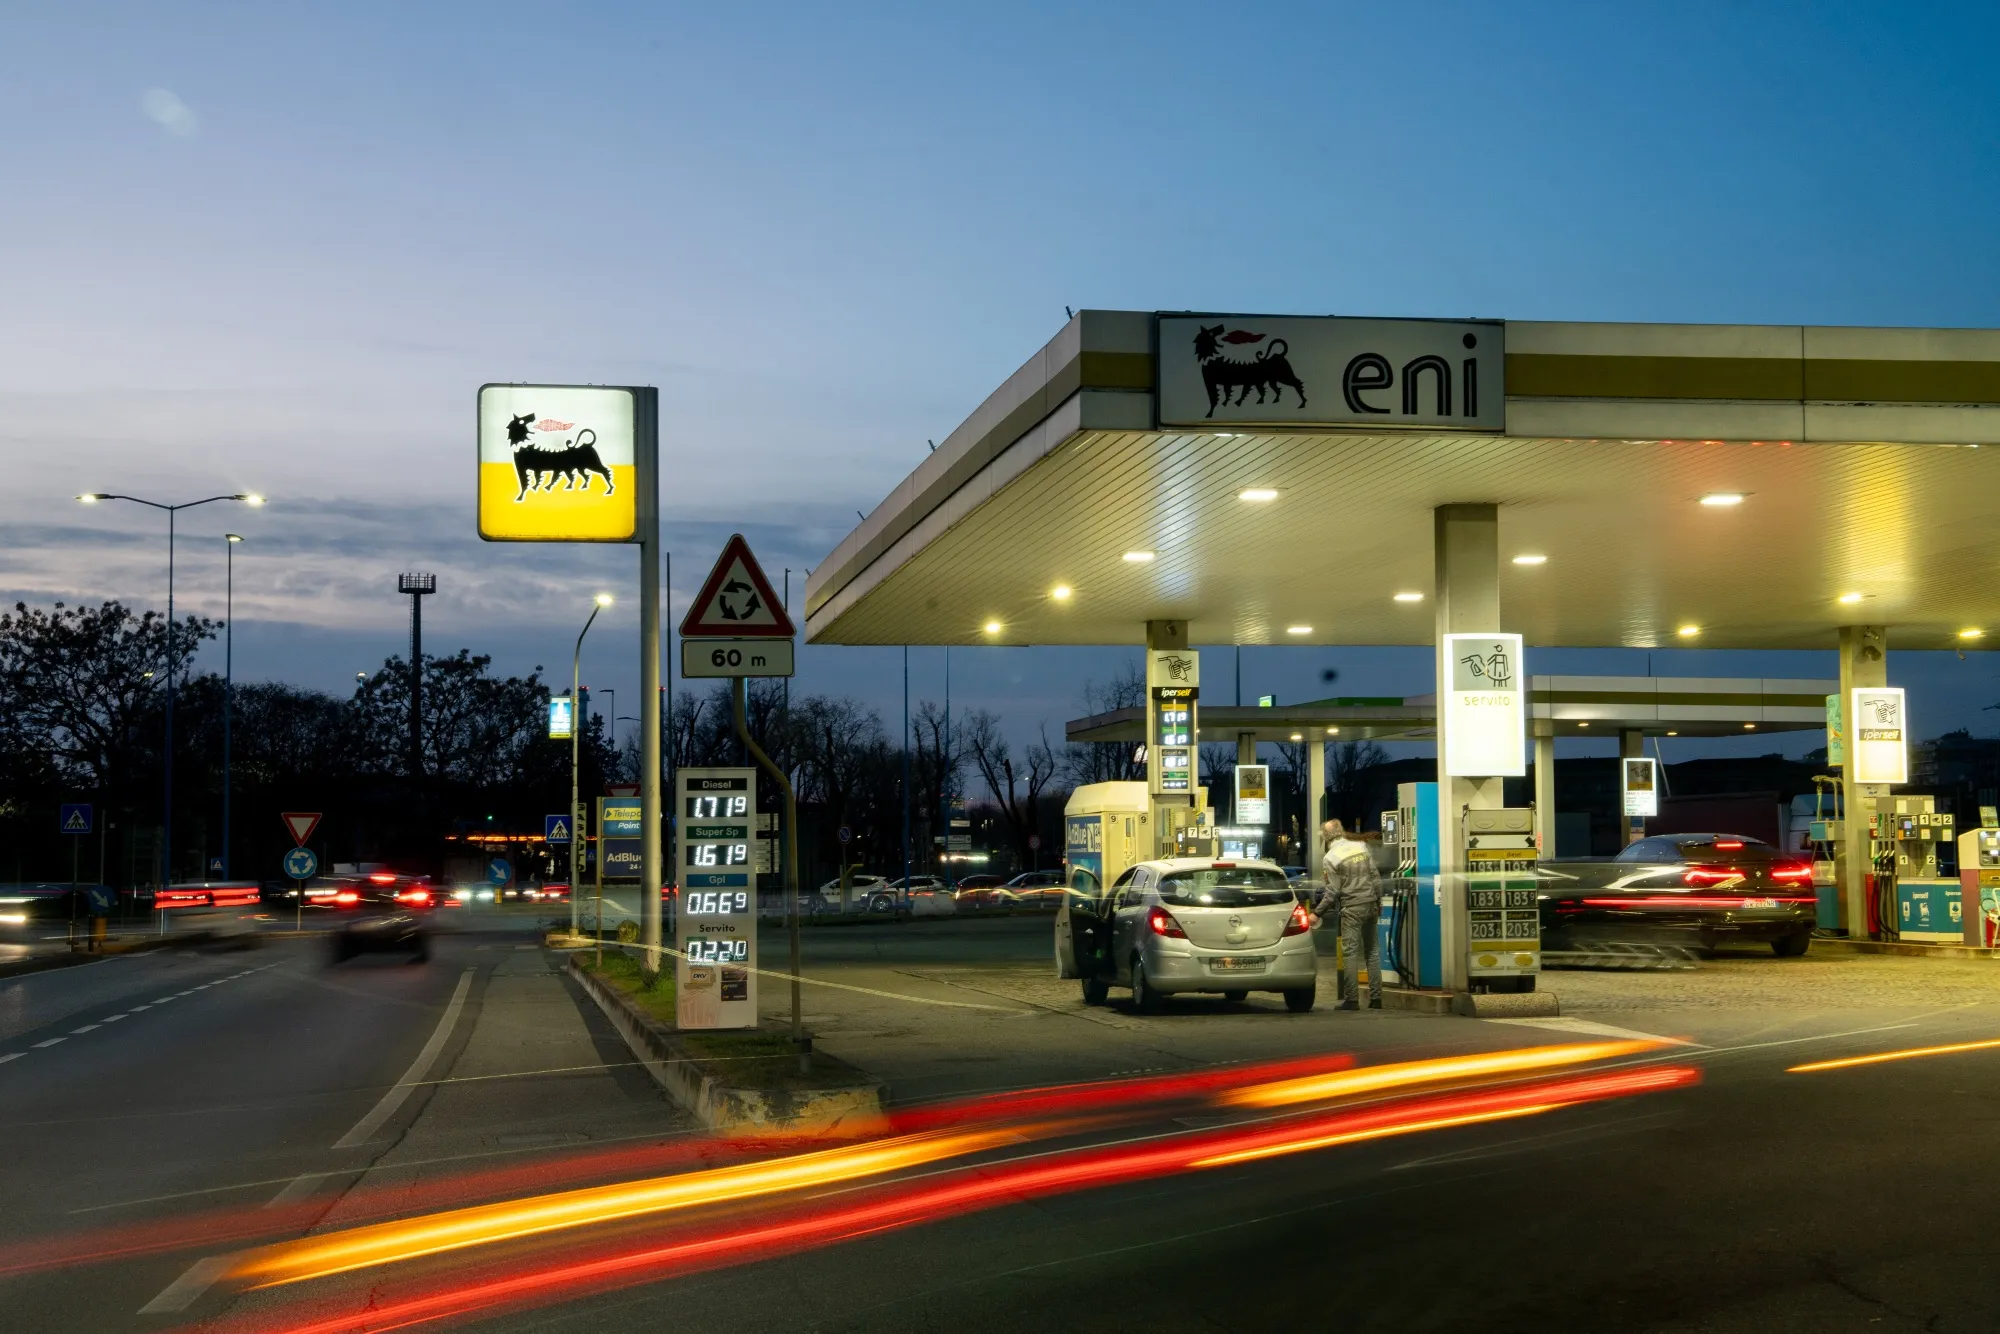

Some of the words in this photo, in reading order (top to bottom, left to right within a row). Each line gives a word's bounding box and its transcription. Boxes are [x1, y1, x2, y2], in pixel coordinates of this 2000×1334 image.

[1343, 332, 1478, 418] eni
[712, 649, 742, 667] 60
[751, 655, 766, 667] m
[1160, 687, 1192, 698] iperself
[1463, 694, 1511, 706] servito
[1864, 729, 1899, 740] iperself
[702, 780, 732, 789] Diesel
[694, 796, 747, 818] 1.719
[1110, 815, 1117, 823] 9
[1140, 815, 1147, 823] 9
[617, 822, 641, 830] Point
[695, 827, 725, 837] Super
[725, 827, 739, 837] Sp
[694, 844, 747, 867] 1.619
[1901, 856, 1906, 864] 1
[1928, 856, 1934, 864] 2
[709, 875, 726, 885] Gpl
[687, 893, 747, 914] 0.669
[699, 923, 736, 933] Servito
[687, 941, 747, 963] 0.220
